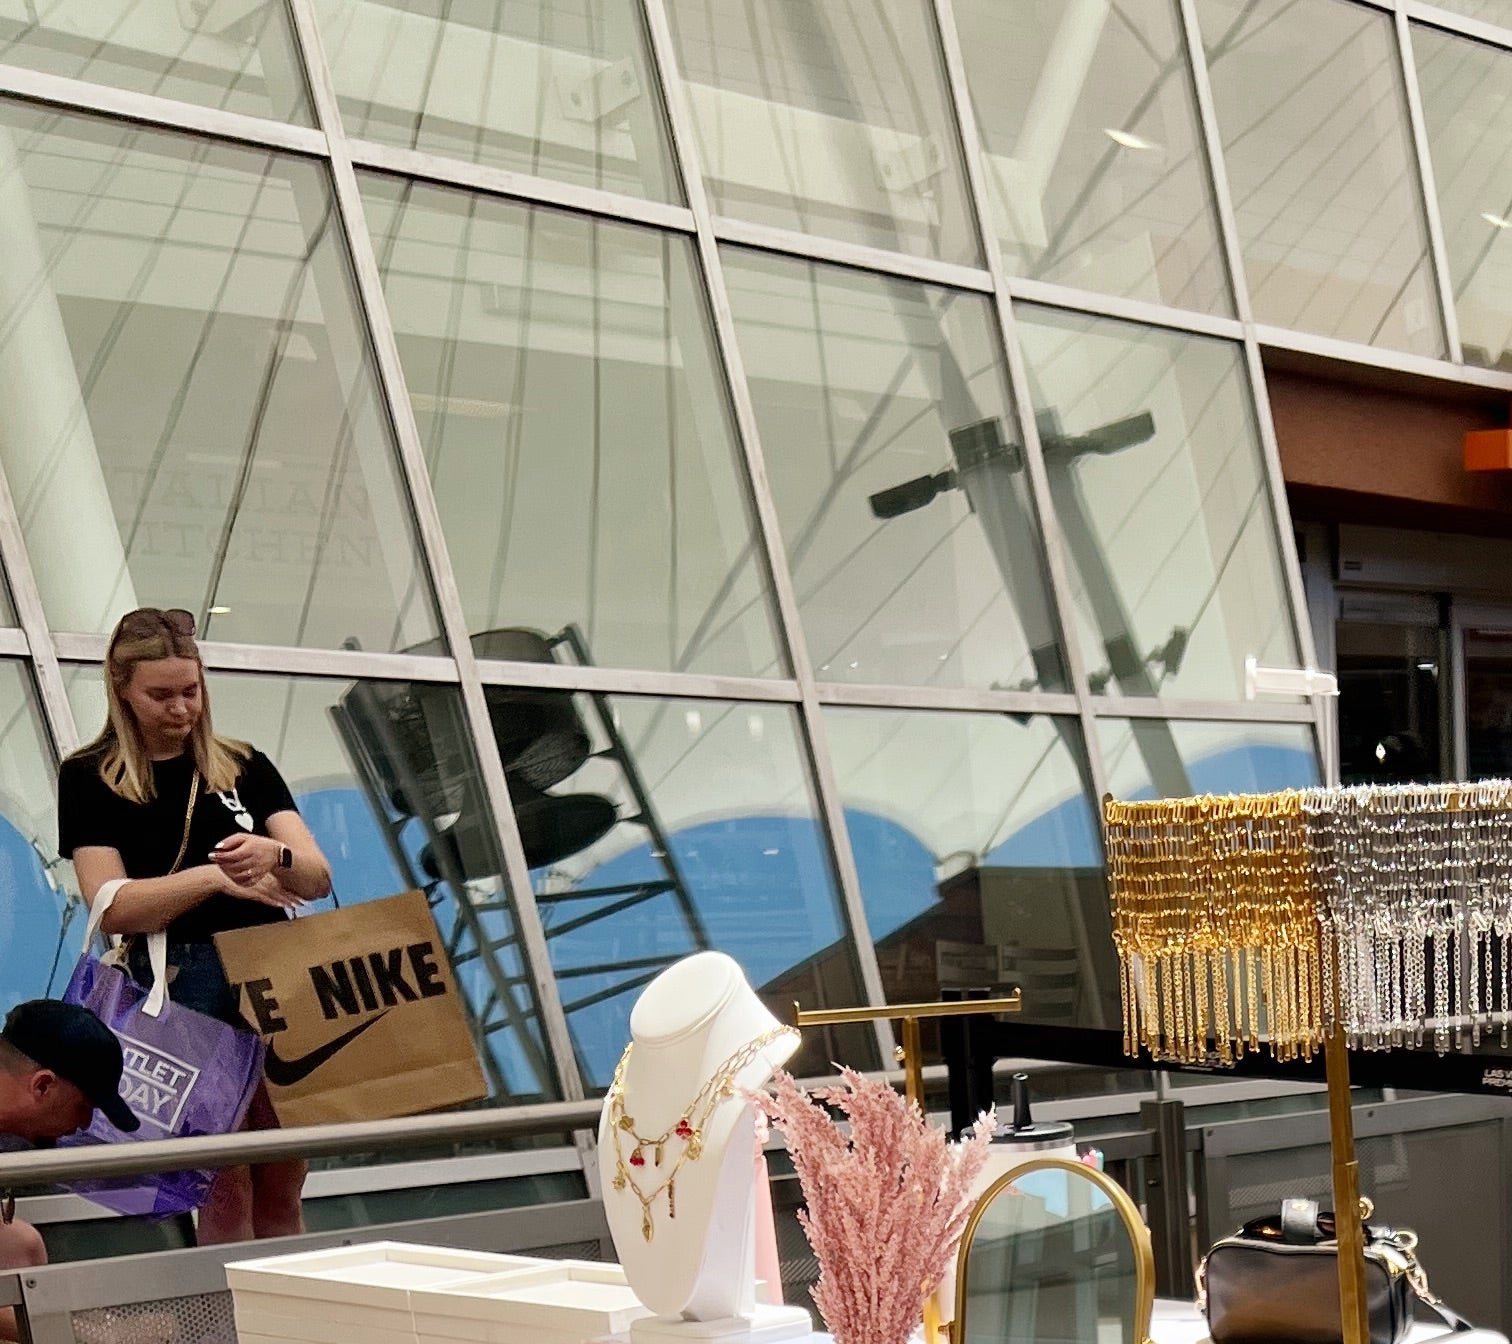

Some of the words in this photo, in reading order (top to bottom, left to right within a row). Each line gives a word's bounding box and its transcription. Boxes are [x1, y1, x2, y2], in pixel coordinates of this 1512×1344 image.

[112, 466, 369, 520] TALIAN
[128, 520, 379, 567] ITCHEN
[308, 941, 447, 1020] NIKE
[122, 1046, 187, 1089] TLET
